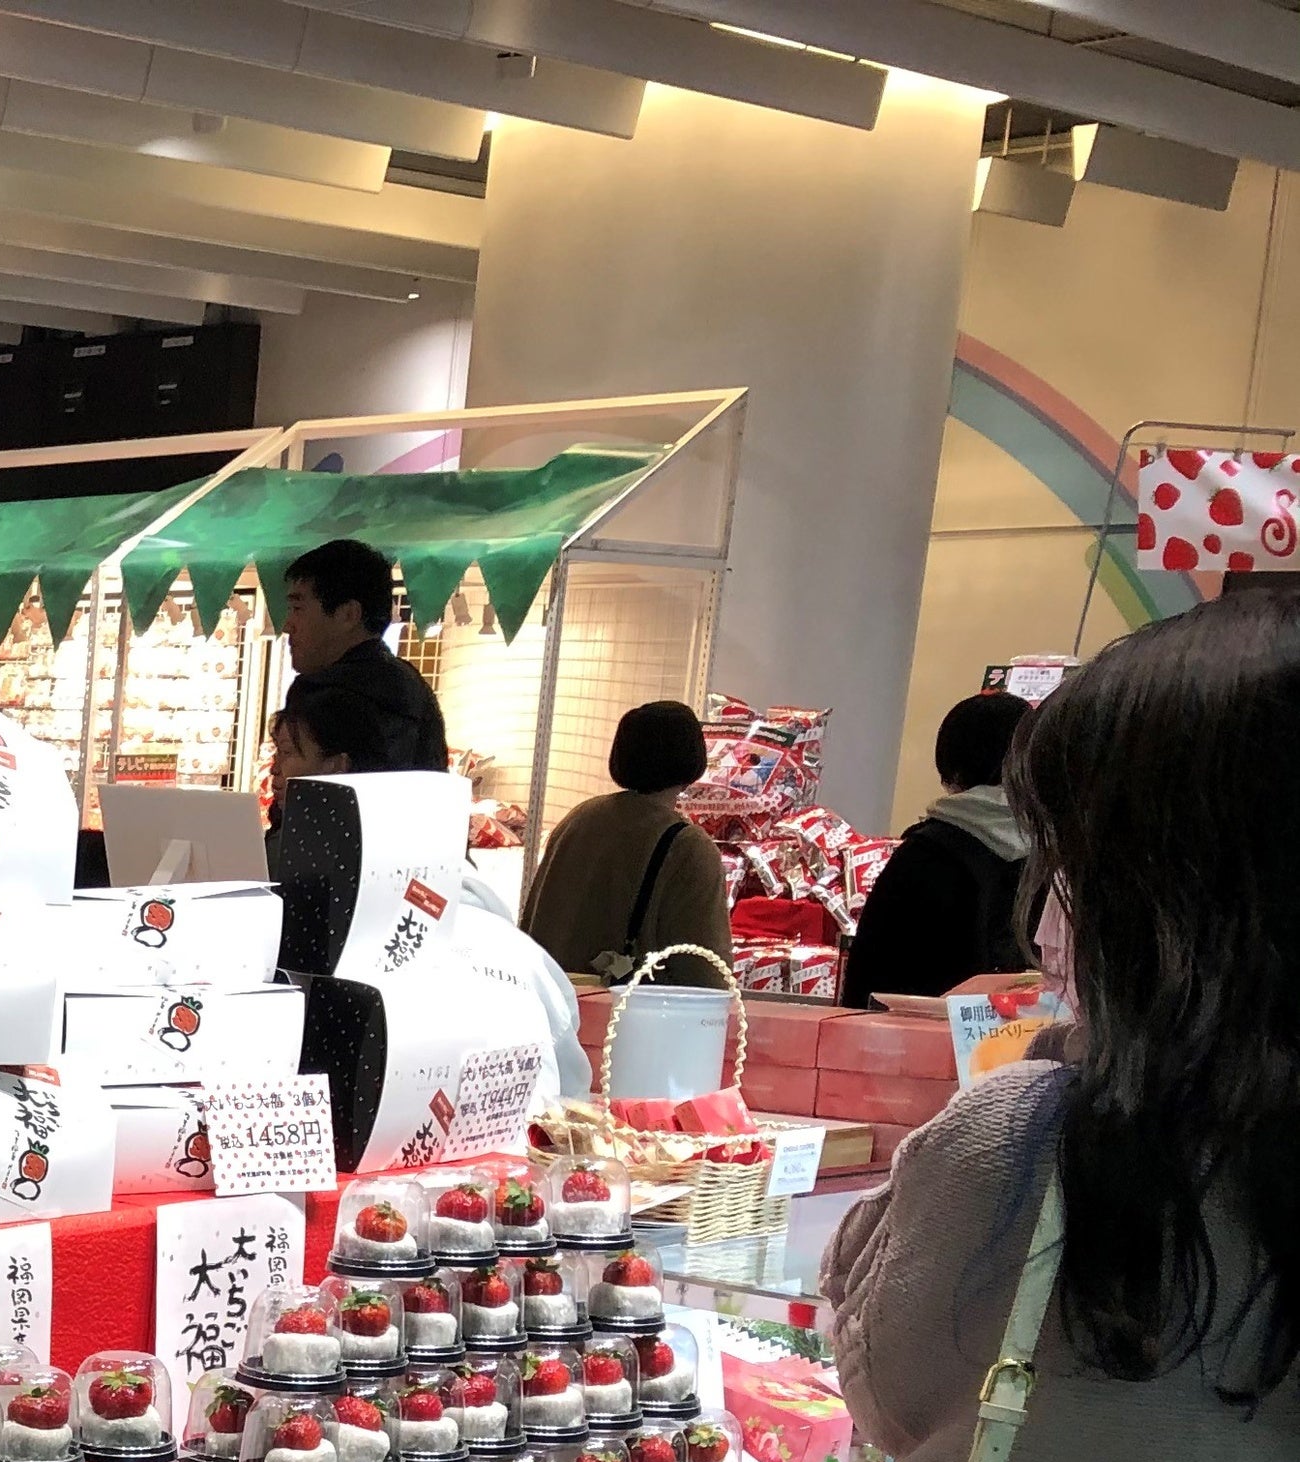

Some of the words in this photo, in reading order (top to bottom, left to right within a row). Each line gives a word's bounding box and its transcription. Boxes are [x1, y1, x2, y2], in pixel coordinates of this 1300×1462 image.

[964, 1022, 1045, 1041] ストロベリー
[176, 1248, 224, 1375] 大福
